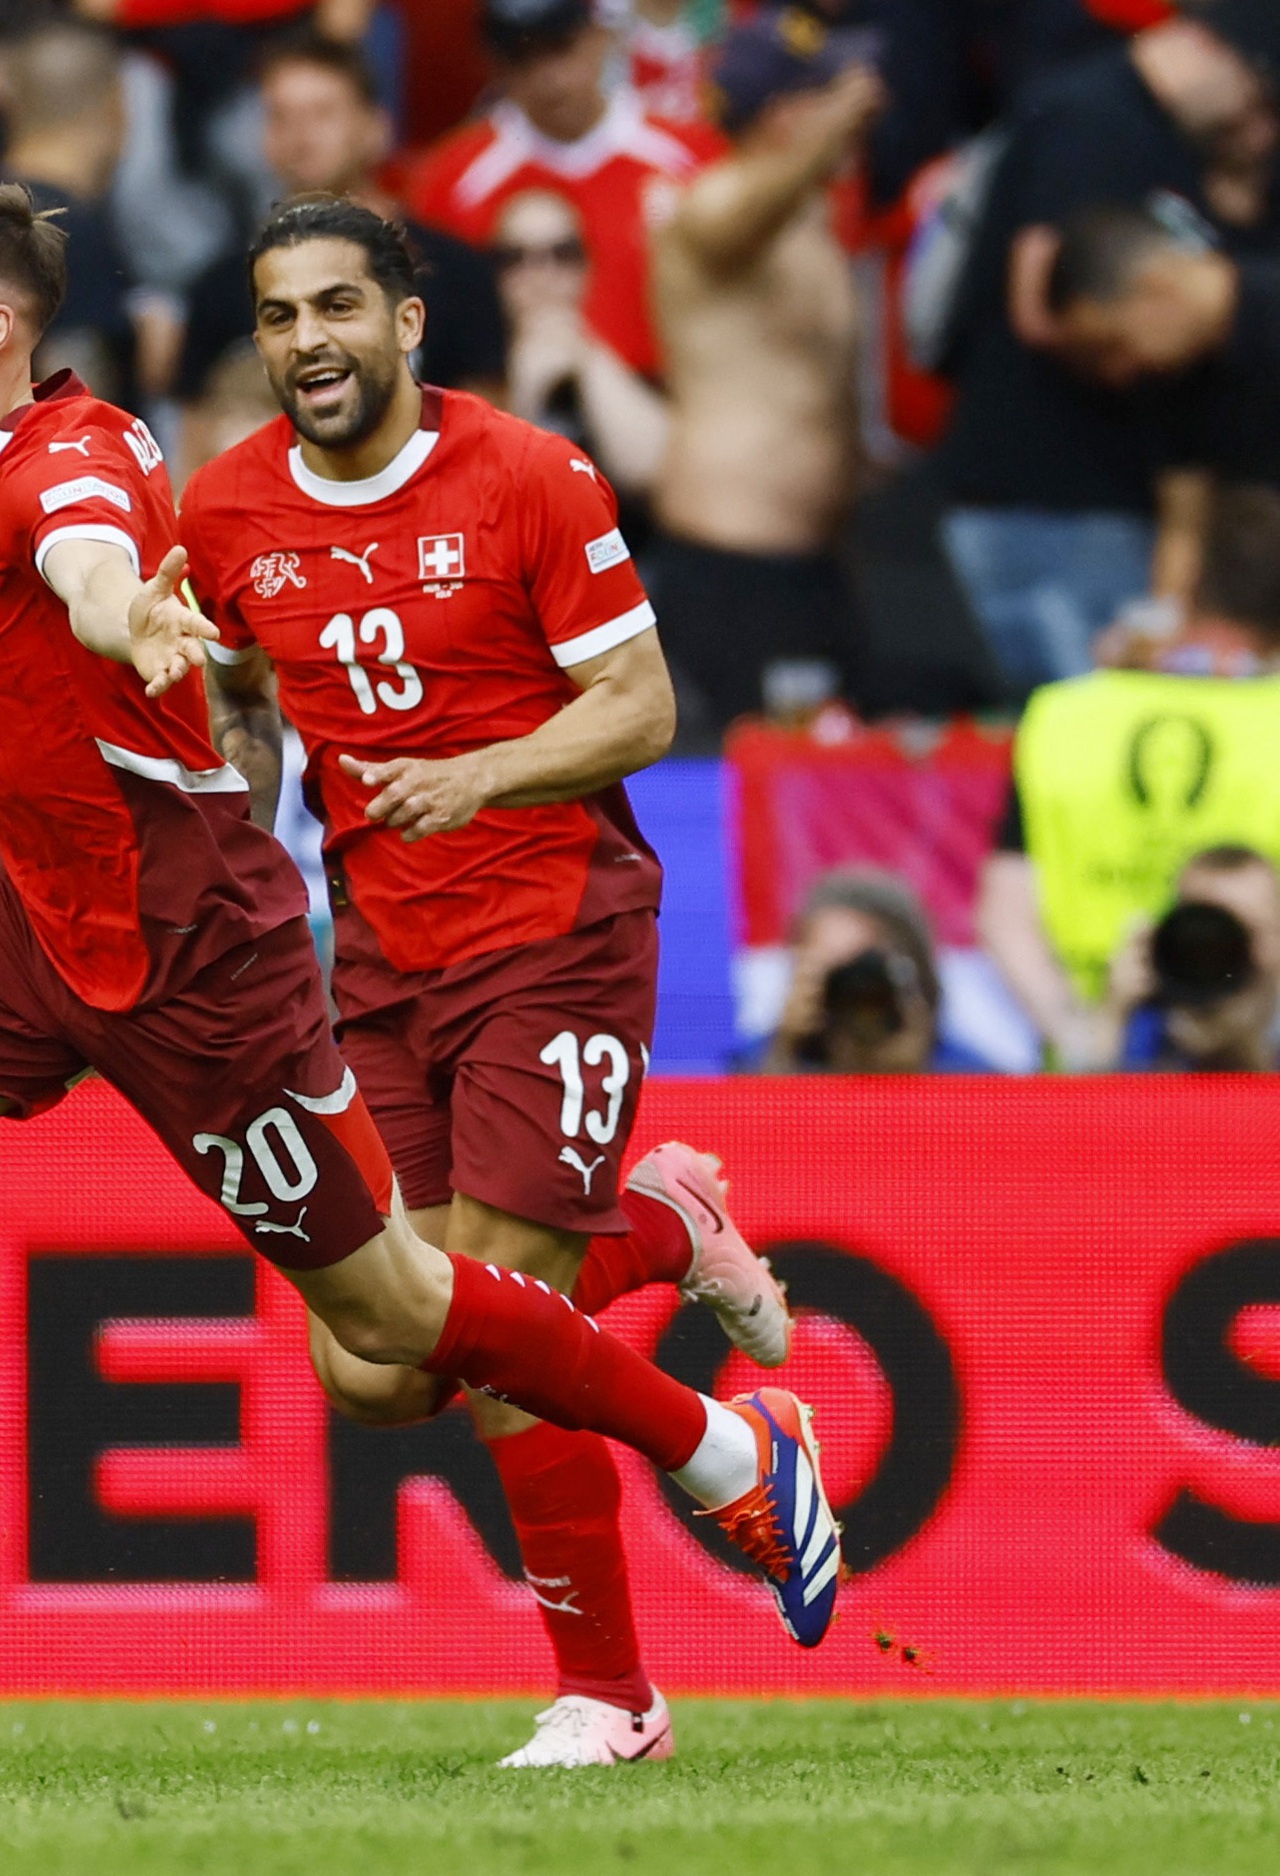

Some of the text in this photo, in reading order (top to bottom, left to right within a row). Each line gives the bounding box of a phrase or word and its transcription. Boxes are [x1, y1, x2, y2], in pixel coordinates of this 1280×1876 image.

[319, 607, 423, 715] 13
[539, 1030, 630, 1144] 13
[192, 1107, 319, 1216] 20
